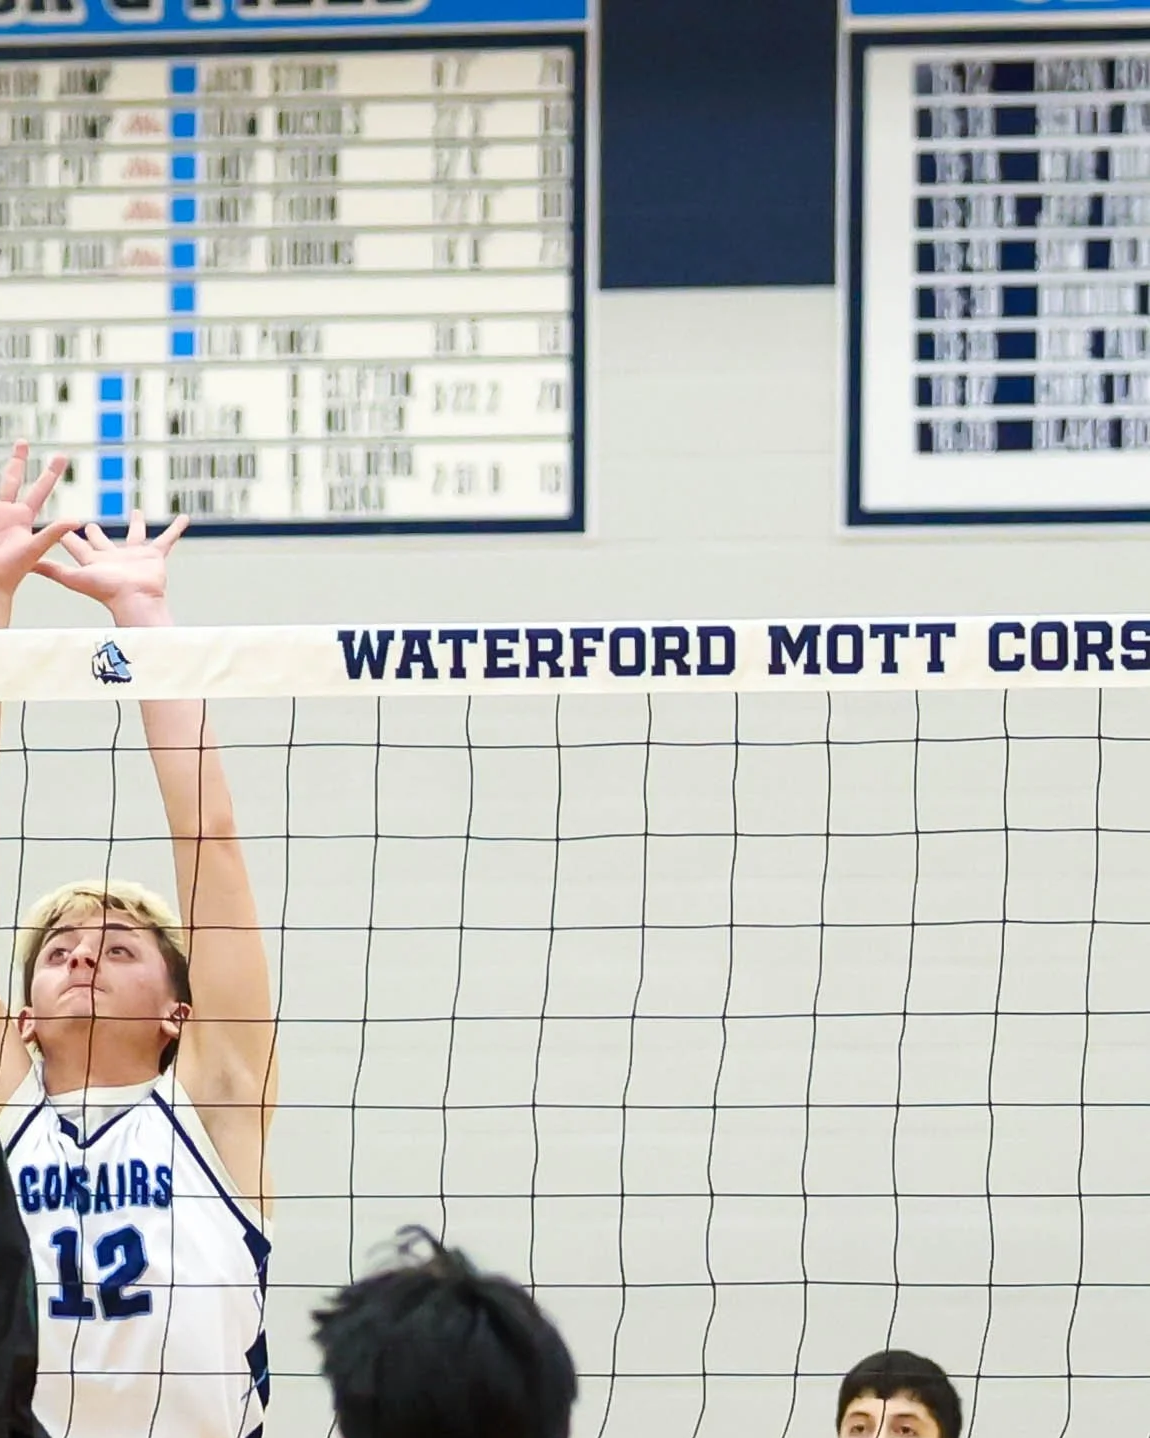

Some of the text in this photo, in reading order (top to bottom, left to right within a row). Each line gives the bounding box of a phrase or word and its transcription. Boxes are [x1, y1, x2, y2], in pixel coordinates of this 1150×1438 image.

[337, 620, 1150, 680] WATERFORD MOTT CORS
[48, 1223, 154, 1322] 12
